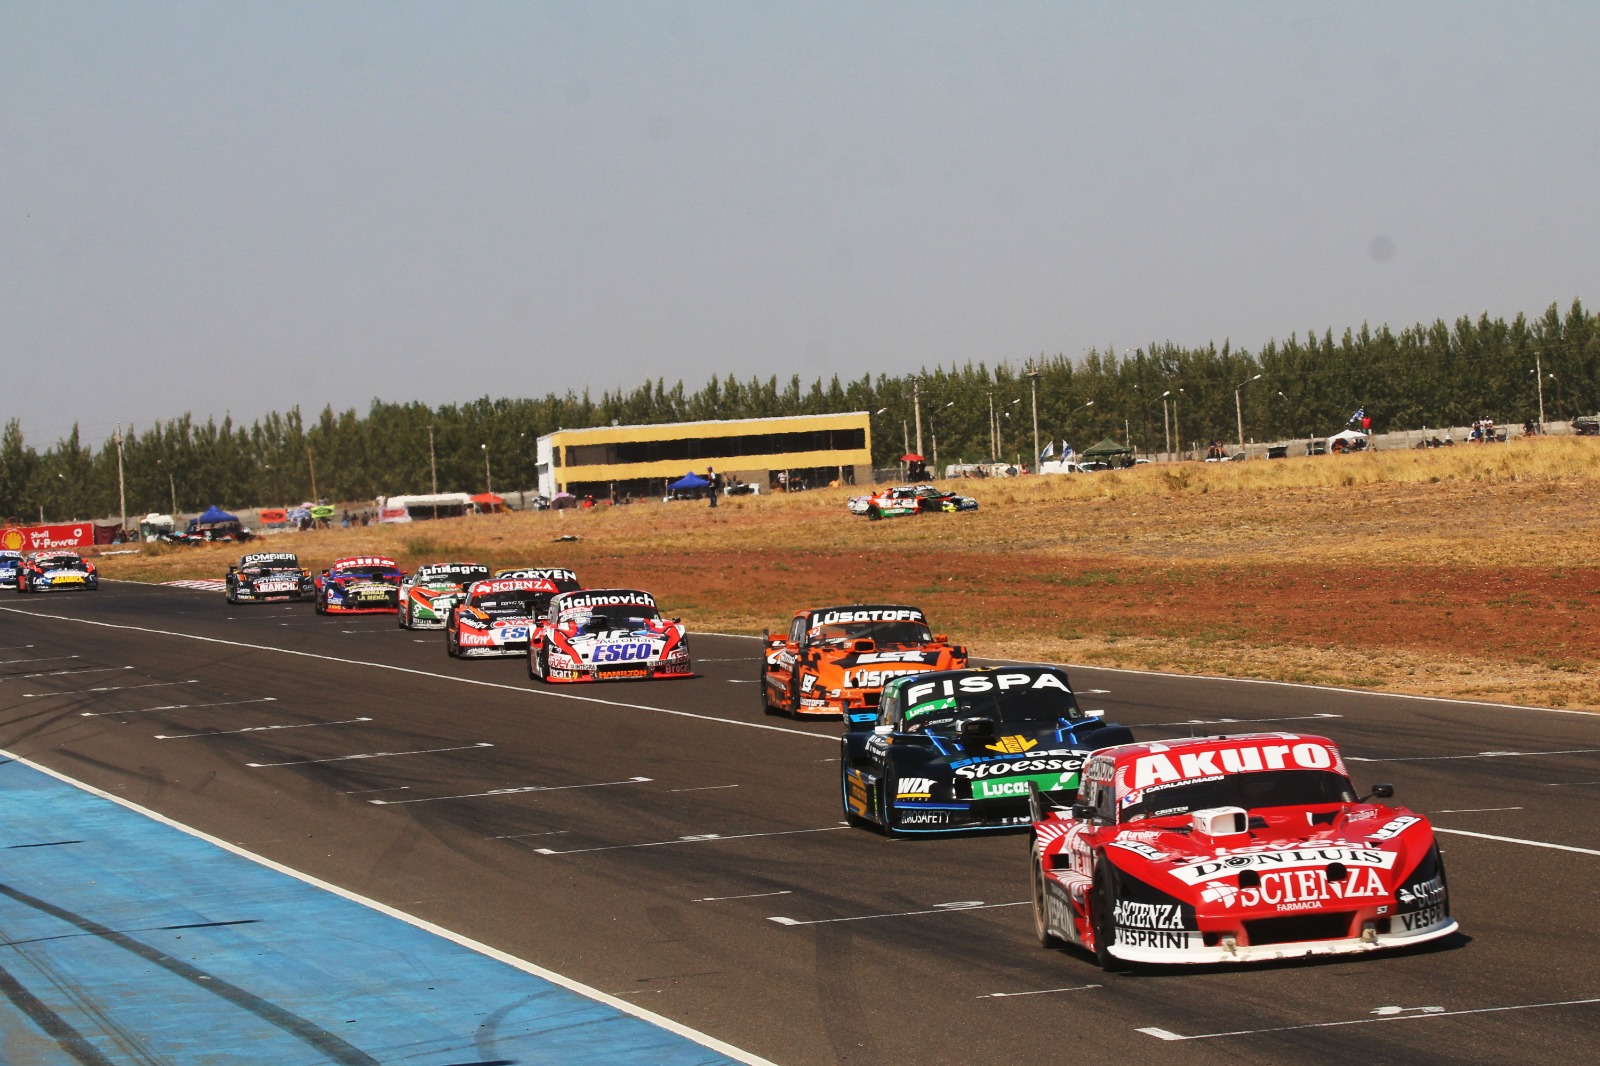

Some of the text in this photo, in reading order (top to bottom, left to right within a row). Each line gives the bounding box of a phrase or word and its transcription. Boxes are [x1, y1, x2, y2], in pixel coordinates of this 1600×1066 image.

[30, 530, 49, 539] Shell
[31, 538, 79, 548] V-Power
[422, 564, 488, 576] philagro
[492, 580, 553, 591] SCIENZA
[559, 592, 655, 611] Haimovich
[592, 643, 652, 662] ESCO
[598, 669, 648, 678] HAMILTON
[907, 673, 1071, 706] FISPA
[909, 704, 935, 717] Lucas
[1135, 743, 1331, 790] Akuro
[897, 777, 939, 794] WIX
[1145, 780, 1191, 793] CATALAN
[1192, 775, 1225, 784] MAGNI
[1154, 806, 1189, 815] CRISTEM
[1293, 848, 1383, 865] LUIS
[1240, 867, 1389, 907] SCIENZA
[1121, 899, 1184, 929] SCIENZA
[1277, 900, 1322, 911] FARMACIA
[1118, 928, 1190, 950] VESPRINI
